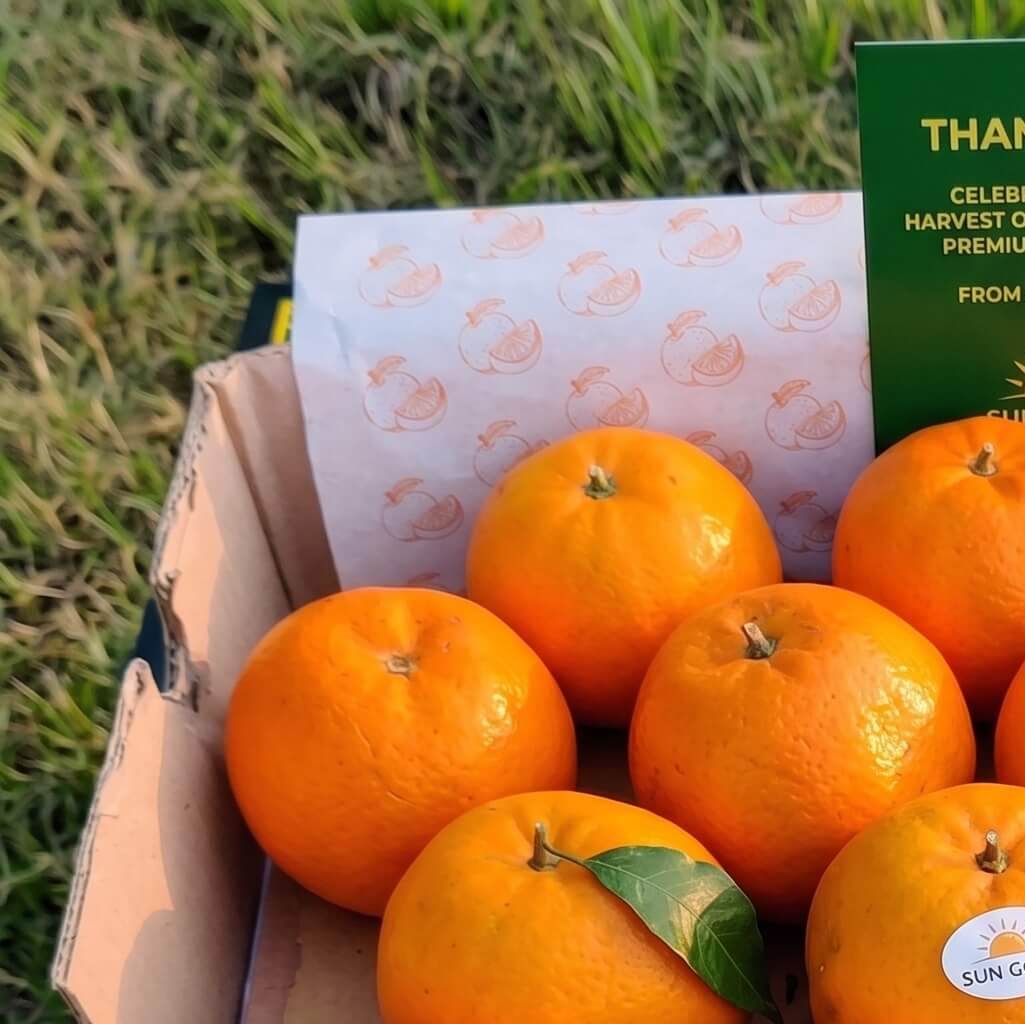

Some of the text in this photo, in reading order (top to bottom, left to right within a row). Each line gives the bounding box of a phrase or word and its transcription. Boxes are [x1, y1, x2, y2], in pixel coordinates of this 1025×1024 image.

[904, 212, 1005, 230] HARVEST
[958, 286, 1021, 303] FROM
[962, 965, 1003, 987] SUN
